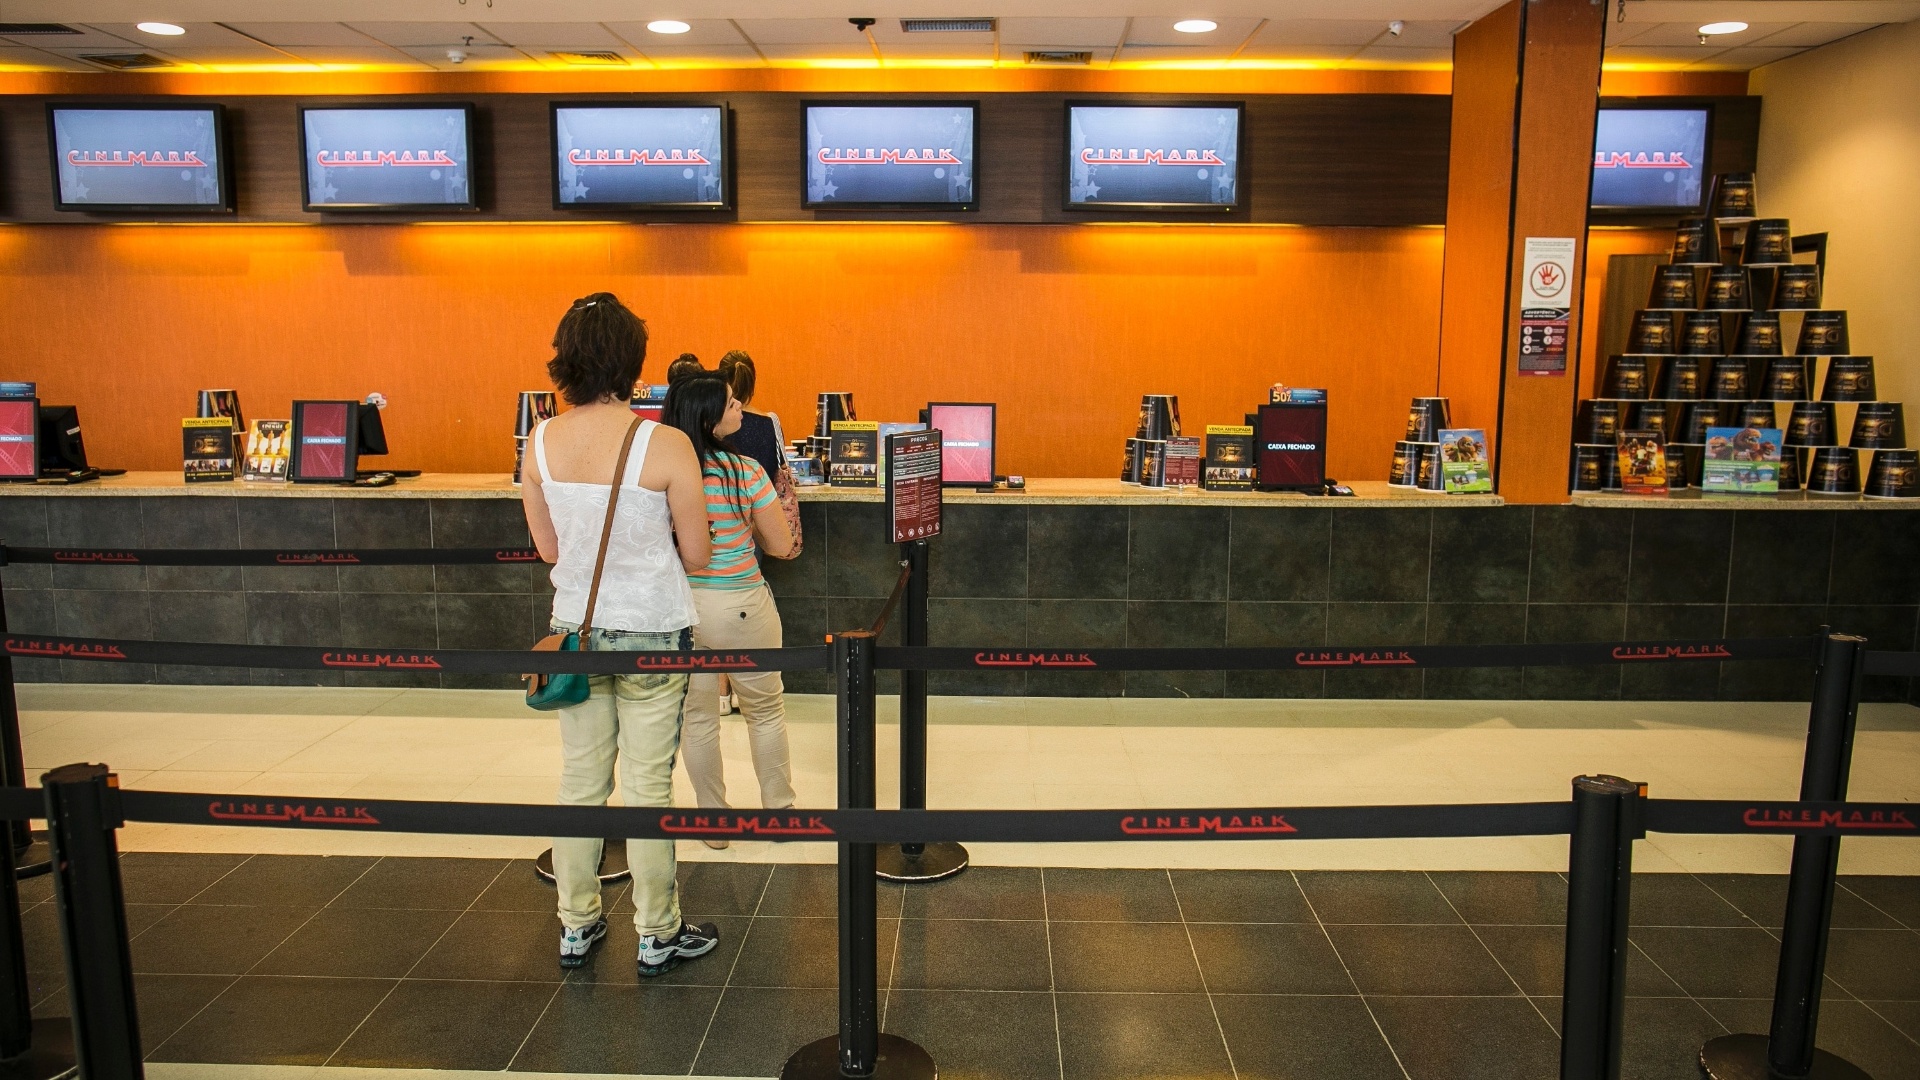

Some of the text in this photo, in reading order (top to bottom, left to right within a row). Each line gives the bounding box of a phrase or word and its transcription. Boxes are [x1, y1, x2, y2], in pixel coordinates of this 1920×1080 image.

[67, 149, 208, 168] CINEMARK
[317, 149, 458, 168] CINEMARK
[568, 147, 711, 166] CINEMARK
[818, 147, 963, 166] CINEMARK
[1081, 147, 1227, 166] CINEMARK
[1594, 151, 1693, 169] EMARK
[632, 387, 652, 399] 50%
[1272, 391, 1292, 402] 50%
[841, 442, 867, 453] DEZ
[54, 552, 140, 563] CINEMARK
[276, 553, 361, 564] CINEMARK
[496, 551, 541, 561] CINE
[4, 639, 127, 659] CINEMARK
[1612, 645, 1732, 660] CINEMARK
[321, 652, 443, 670] CINEMARK
[636, 655, 758, 670] CINEMARK
[973, 652, 1097, 667] CINEMARK
[1295, 651, 1417, 667] CINEMARK
[209, 802, 380, 825] CINEMARK
[1743, 808, 1918, 830] CINEMARK
[659, 815, 836, 836] CINEMARK
[1121, 815, 1298, 836] CINEMARK
